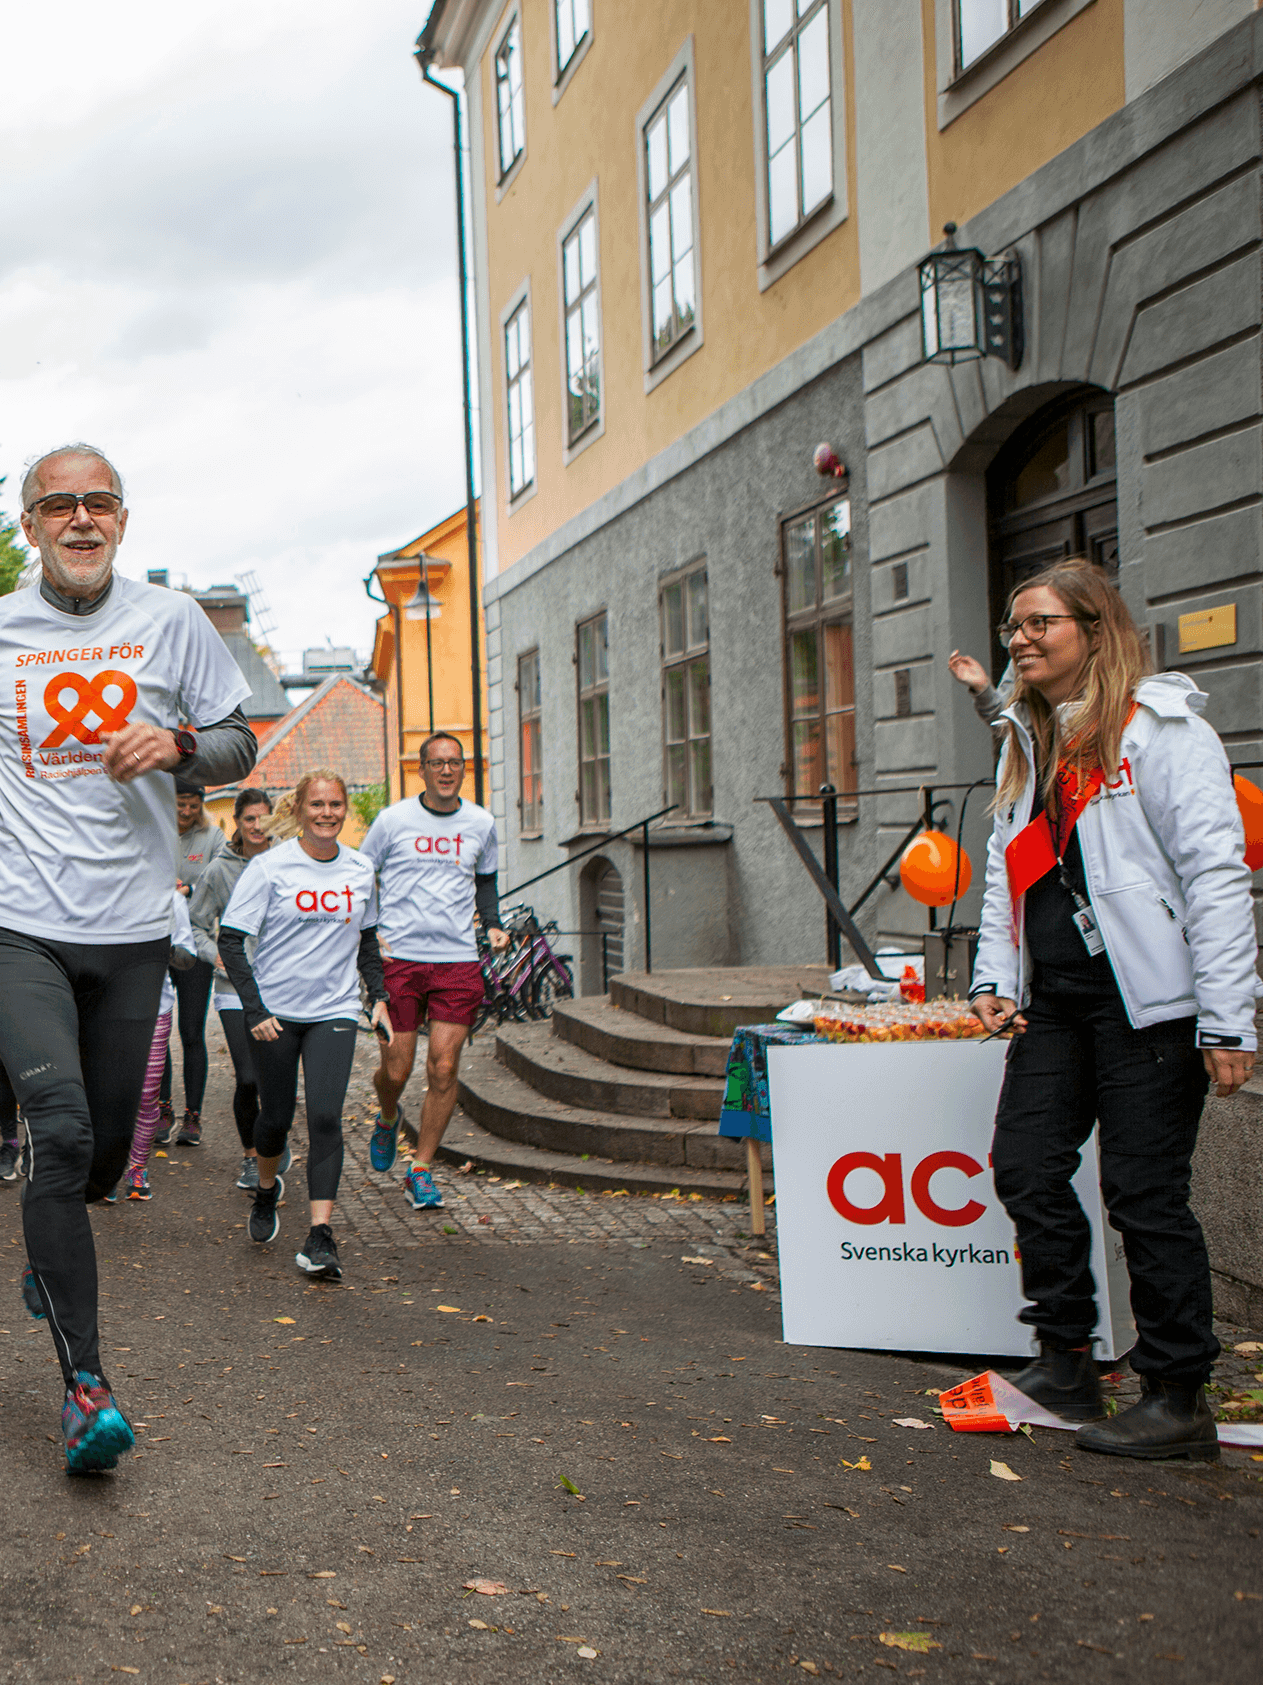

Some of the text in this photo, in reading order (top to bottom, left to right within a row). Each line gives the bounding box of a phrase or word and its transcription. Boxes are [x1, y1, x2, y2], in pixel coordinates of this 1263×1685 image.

[15, 642, 144, 667] SPRINGER FÖR
[415, 833, 464, 856] act
[296, 885, 354, 913] act
[827, 1151, 994, 1227] ac
[841, 1241, 1010, 1268] Svenska kyrkan
